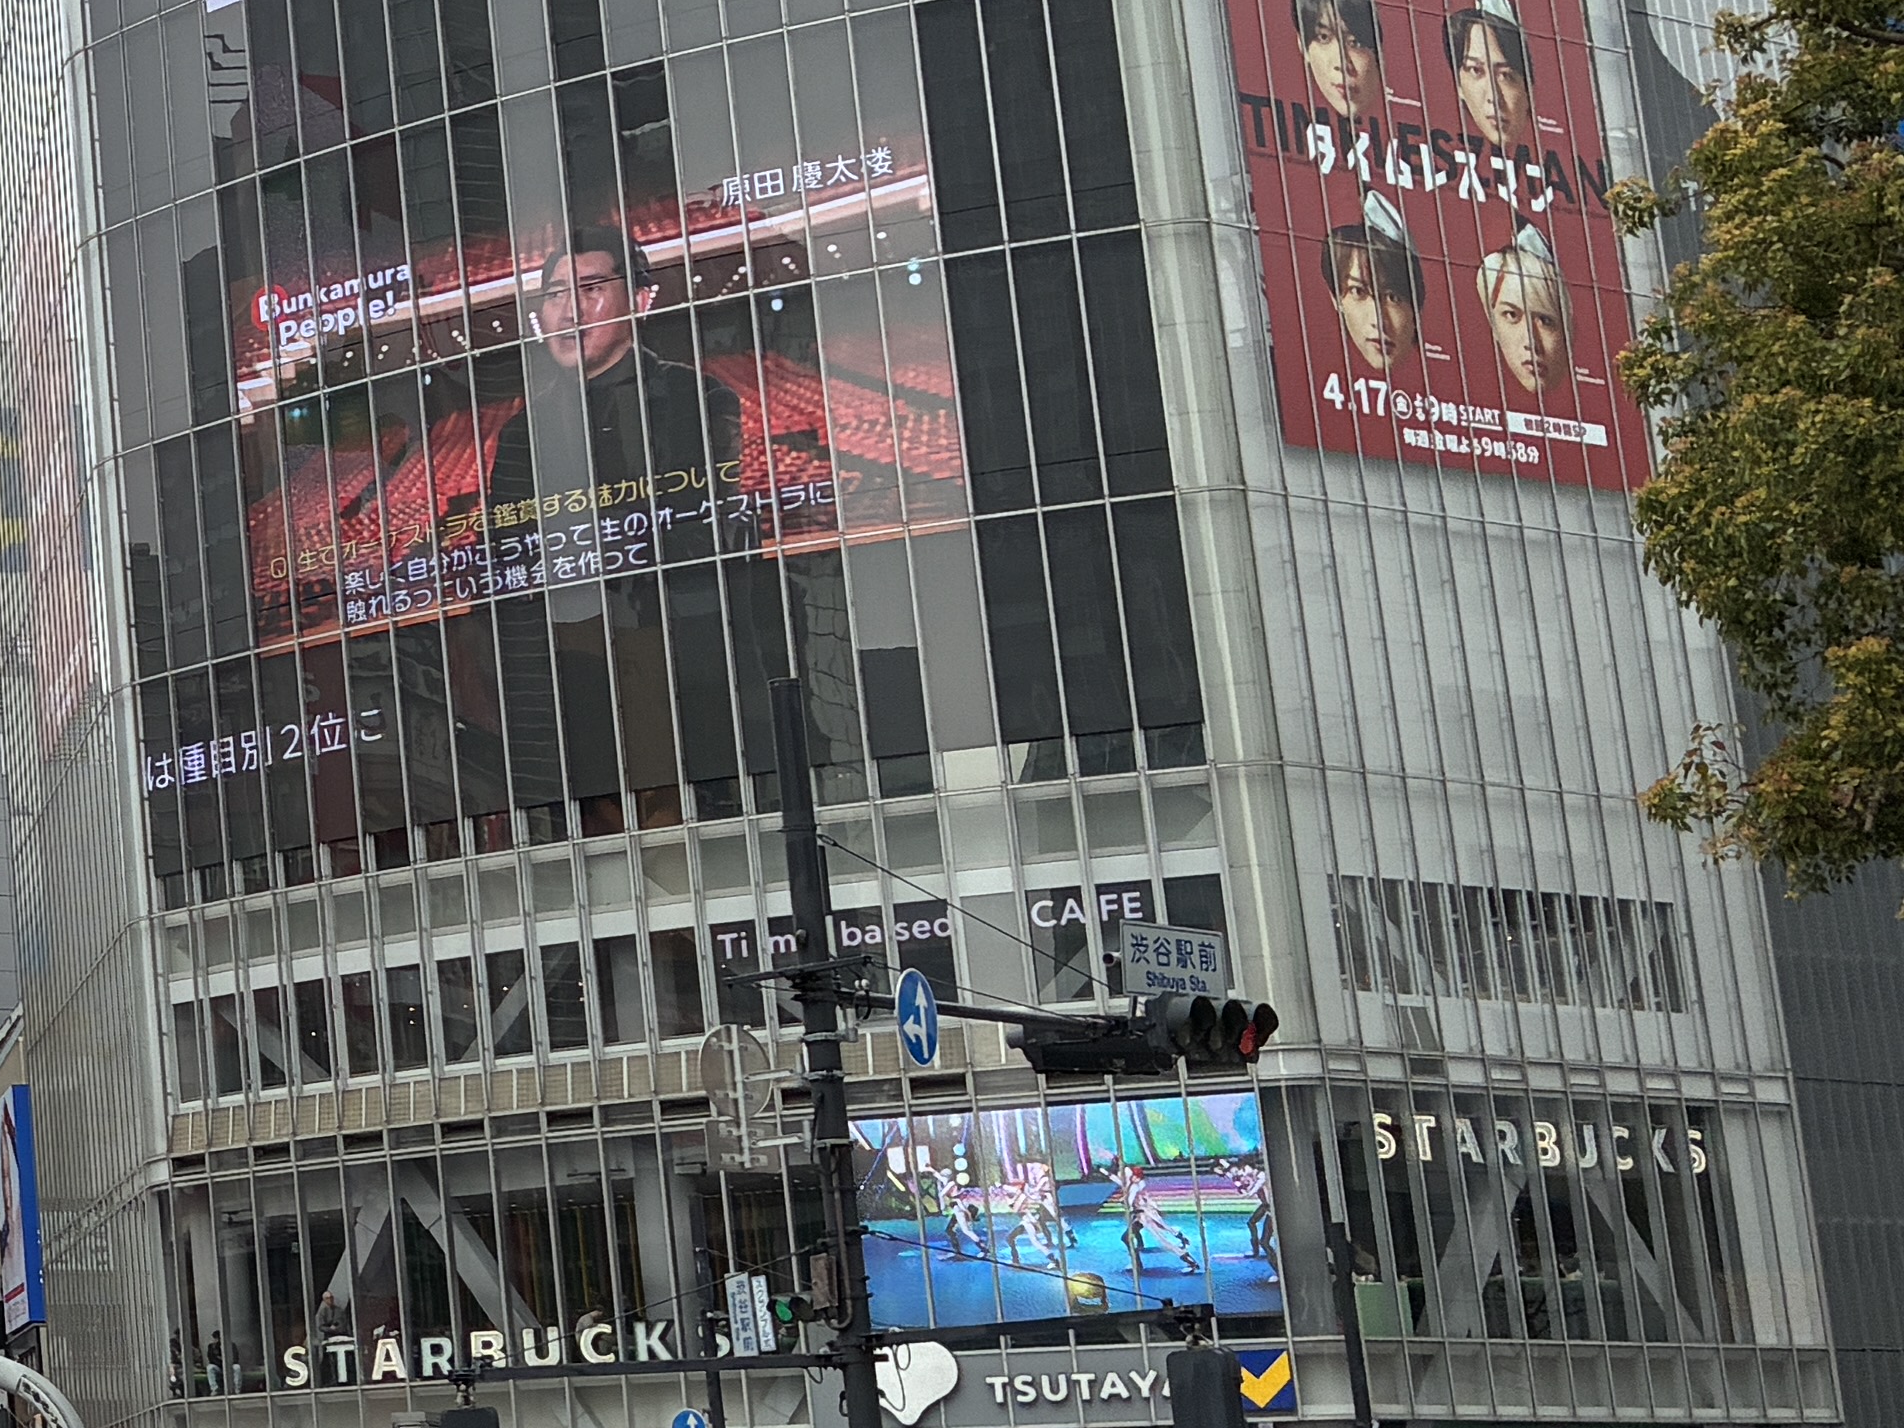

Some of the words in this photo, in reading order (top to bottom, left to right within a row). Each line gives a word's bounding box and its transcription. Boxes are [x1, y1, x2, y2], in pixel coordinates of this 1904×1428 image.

[1323, 372, 1388, 417] 4.17
[1459, 405, 1502, 426] START
[1030, 891, 1144, 928] CAFE
[717, 927, 796, 963] Tim
[840, 909, 954, 949] based
[1130, 932, 1218, 973] 渋谷駅前
[1145, 970, 1187, 993] Shibuya
[1371, 1112, 1708, 1175] STARBUCKS
[282, 1318, 732, 1388] STARBUCKS
[985, 1368, 1177, 1404] TSUTAY
